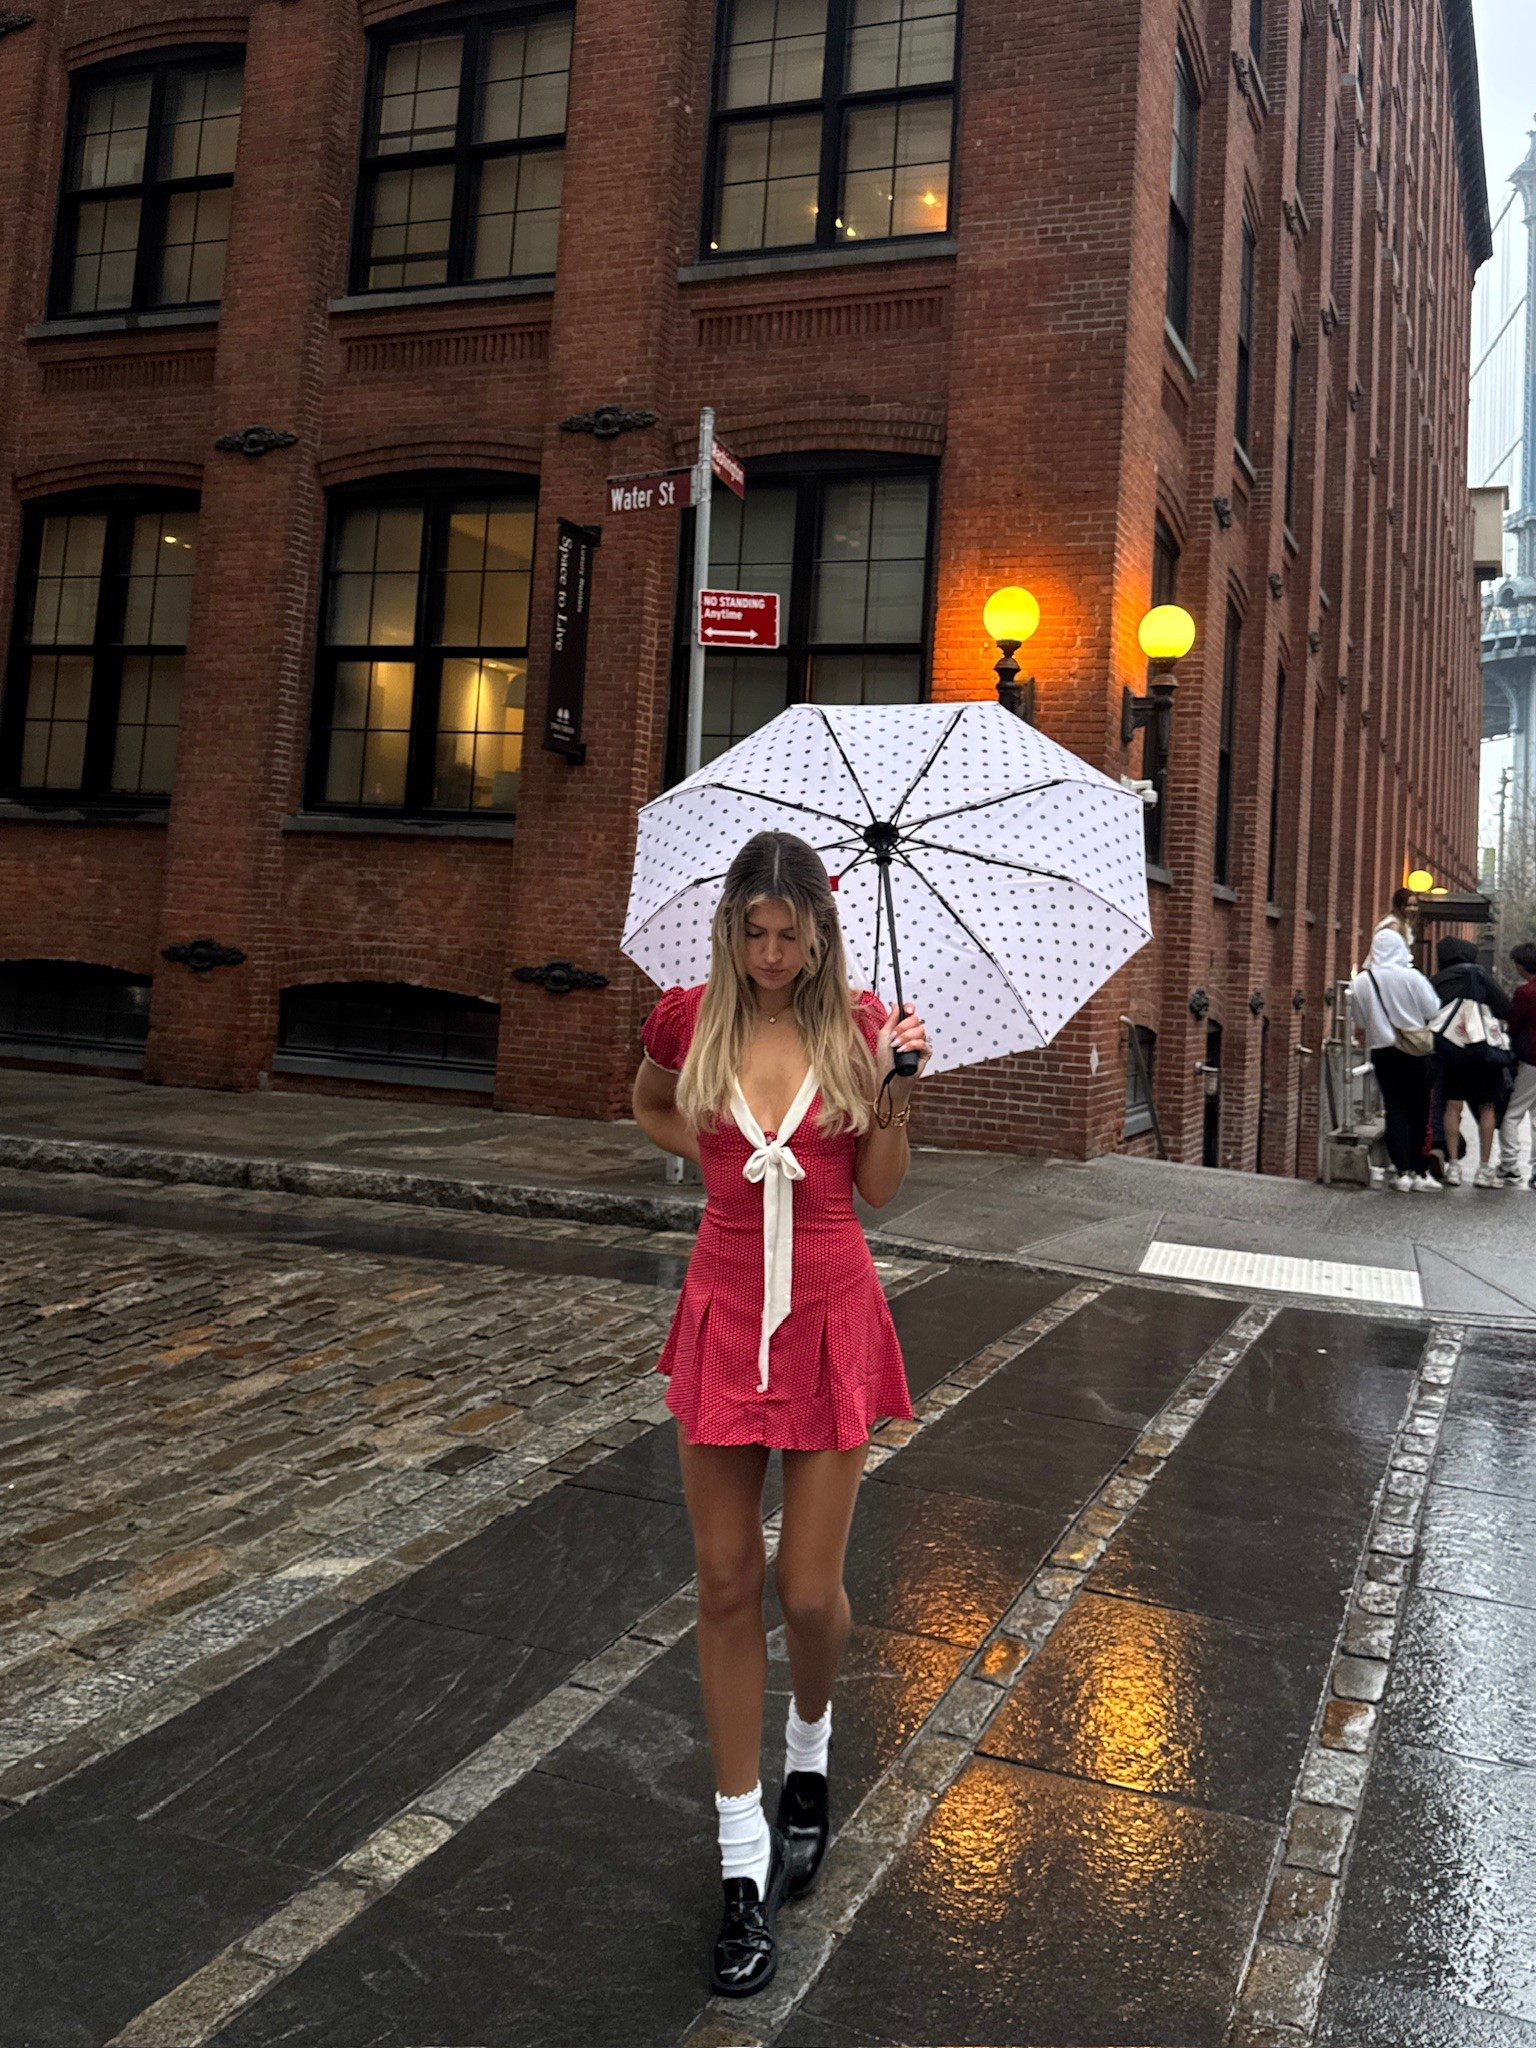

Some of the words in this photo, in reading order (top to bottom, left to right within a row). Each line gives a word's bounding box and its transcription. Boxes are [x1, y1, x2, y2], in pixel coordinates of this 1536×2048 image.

[610, 486, 653, 512] Water
[658, 481, 676, 507] St
[559, 535, 573, 586] Space
[558, 591, 567, 608] to
[703, 596, 718, 607] NO
[719, 597, 766, 610] STANDING
[704, 608, 743, 621] Anytime
[555, 612, 568, 651] Live
